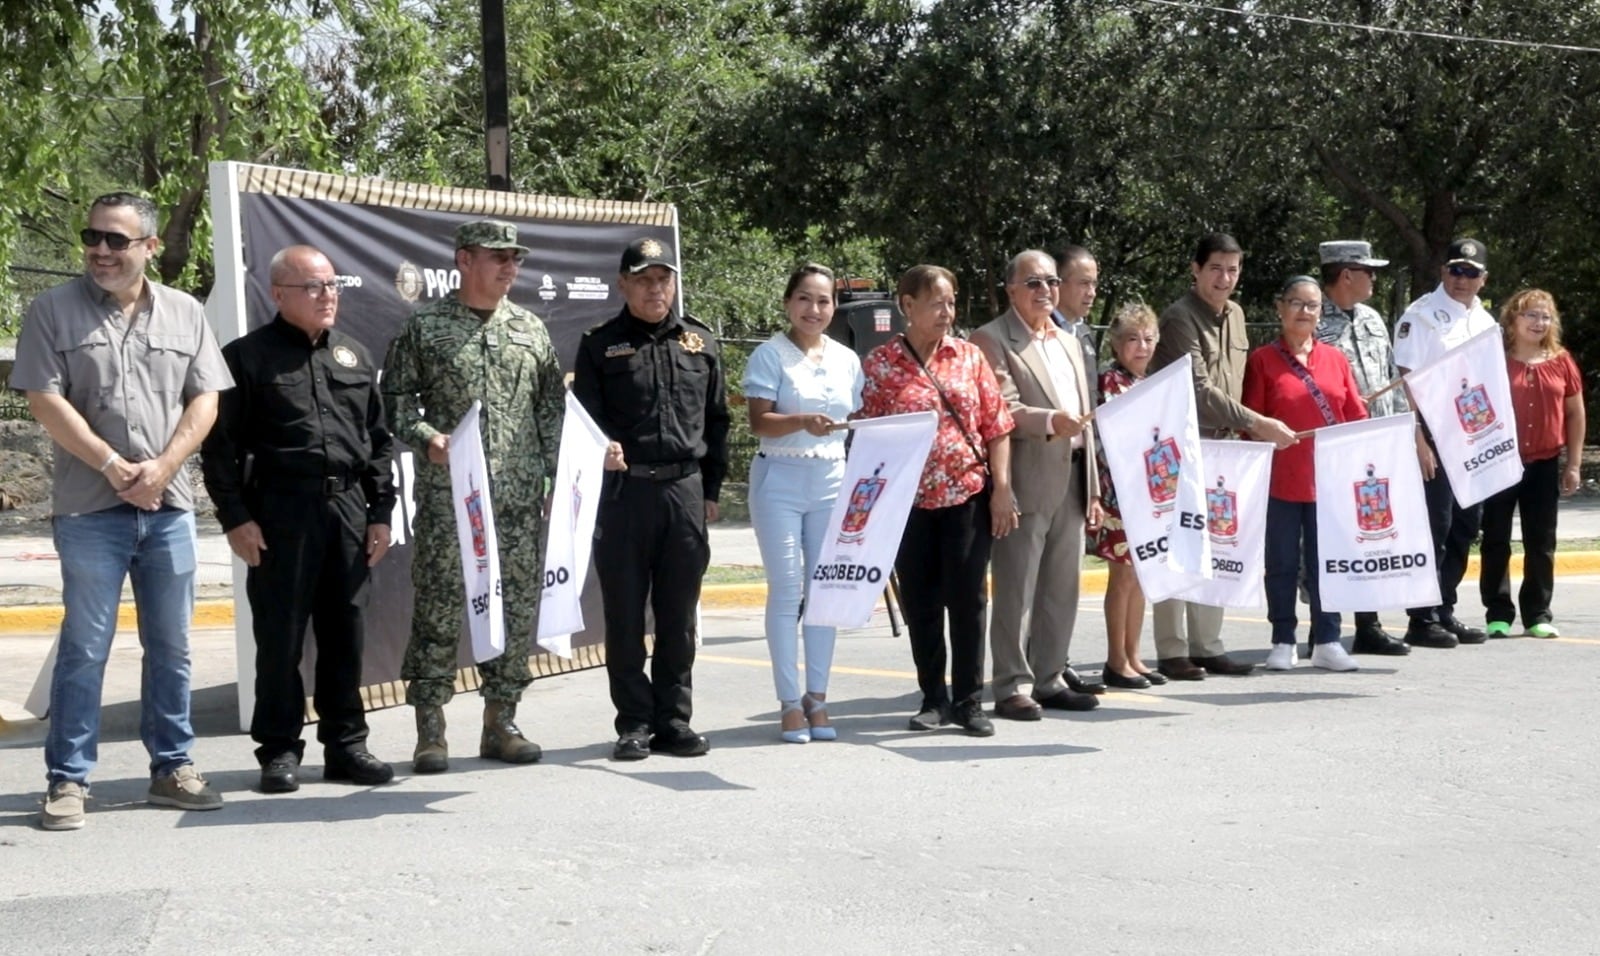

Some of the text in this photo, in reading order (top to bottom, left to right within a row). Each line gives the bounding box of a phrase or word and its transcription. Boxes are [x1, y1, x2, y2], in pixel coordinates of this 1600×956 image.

[1463, 437, 1515, 472] ESCOBED
[1180, 511, 1206, 530] ES
[1135, 536, 1169, 561] ESC
[1211, 558, 1244, 574] OBEDO
[1325, 553, 1427, 573] ESCOBEDO
[813, 564, 882, 584] ESCOBEDO
